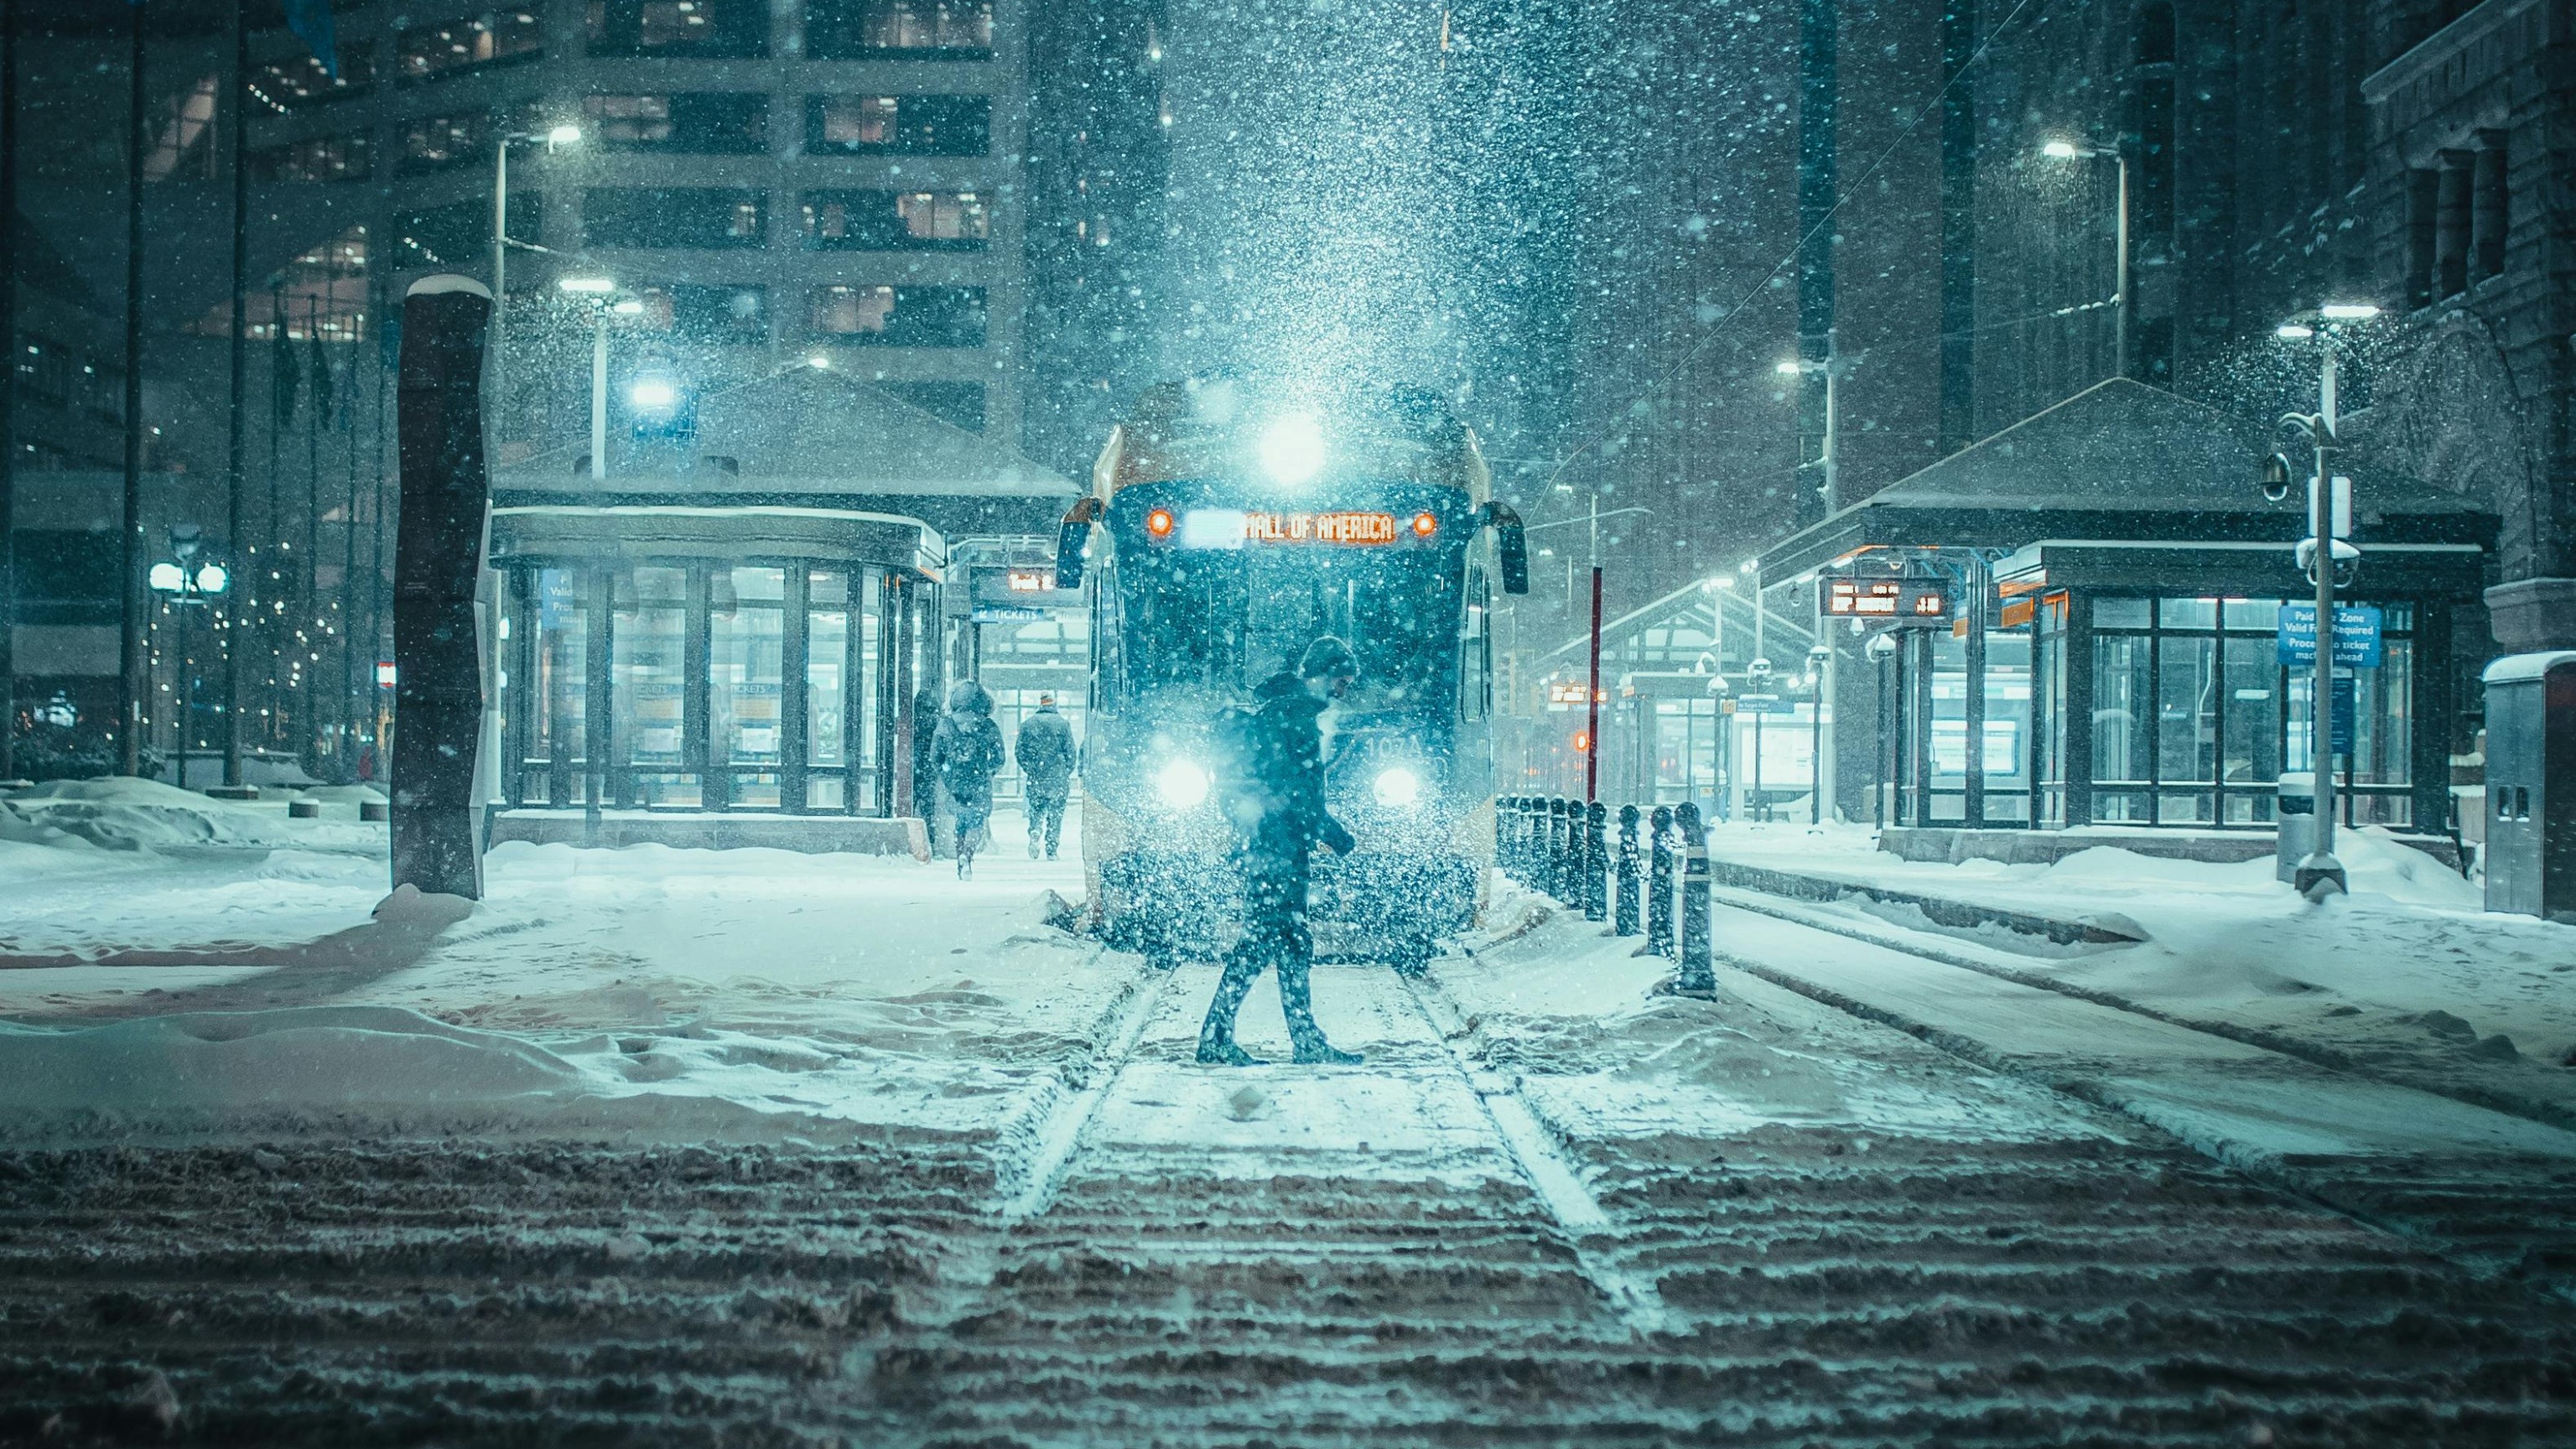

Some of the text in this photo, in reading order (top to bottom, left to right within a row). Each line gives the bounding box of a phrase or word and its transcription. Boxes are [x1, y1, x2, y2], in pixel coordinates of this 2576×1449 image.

[1244, 515, 1392, 540] MALL OF AMERICA
[995, 610, 1037, 620] TICKETS
[2295, 611, 2314, 621] Paid
[2340, 612, 2365, 623] Zone
[2285, 623, 2307, 632] Valid
[2332, 624, 2374, 636] Required
[2289, 637, 2316, 648] Proce
[2342, 641, 2370, 650] ticket
[2335, 653, 2363, 662] ahead
[1366, 735, 1424, 757] 107A
